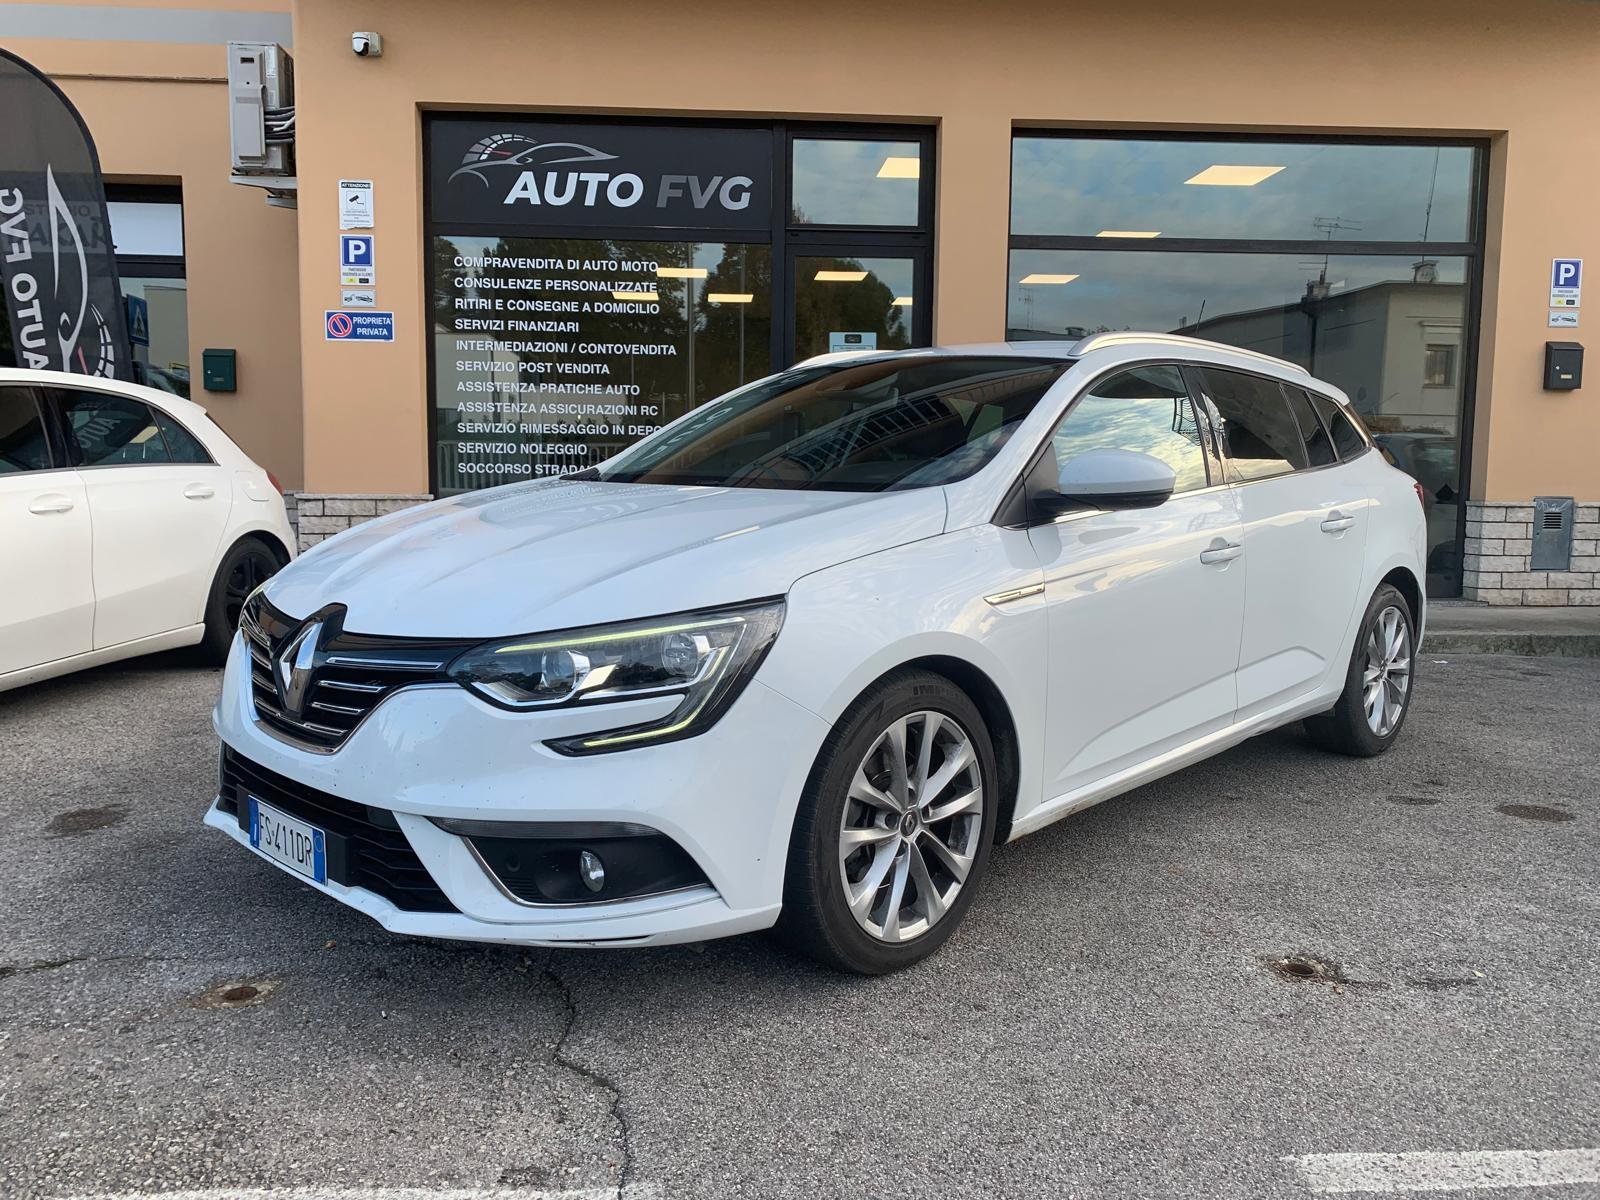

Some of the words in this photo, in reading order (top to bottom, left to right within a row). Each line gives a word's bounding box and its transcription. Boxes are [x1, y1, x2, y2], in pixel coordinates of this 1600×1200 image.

[503, 171, 644, 208] AUTO
[655, 175, 754, 211] FVG
[349, 240, 366, 263] P
[453, 256, 564, 270] COMPRAVENDITA
[567, 259, 580, 270] DI
[582, 260, 618, 271] AUTO
[621, 261, 659, 272] MOTO
[1559, 263, 1576, 285] P
[454, 277, 542, 290] CONSULENZE
[545, 280, 657, 292] PERSONALIZZATE
[455, 298, 491, 310] RITIRI
[495, 299, 503, 310] E
[506, 300, 579, 312] CONSEGNE
[582, 301, 591, 312] A
[594, 302, 660, 314] DOMICILIO
[356, 327, 388, 336] PRIVATA
[454, 319, 504, 331] SERVIZI
[507, 320, 579, 333] FINANZIARI
[456, 340, 568, 353] INTERMEDIAZIONI
[578, 343, 677, 355] CONTOVENDITA
[456, 361, 515, 372] SERVIZIO
[518, 362, 553, 373] POST
[556, 363, 610, 374] VENDITA
[456, 381, 537, 393] ASSISTENZA
[539, 383, 602, 394] PRATICHE
[605, 384, 640, 396] AUTO
[457, 402, 537, 413] ASSISTENZA
[539, 403, 637, 416] ASSICURAZIONI
[641, 406, 659, 416] RC
[457, 422, 516, 433] SERVIZIO
[519, 424, 609, 435] RIMESSAGGIO
[612, 425, 625, 435] IN
[457, 443, 517, 454] SERVIZIO
[520, 443, 588, 455] NOLEGGIO
[458, 463, 532, 474] SOCCORSO
